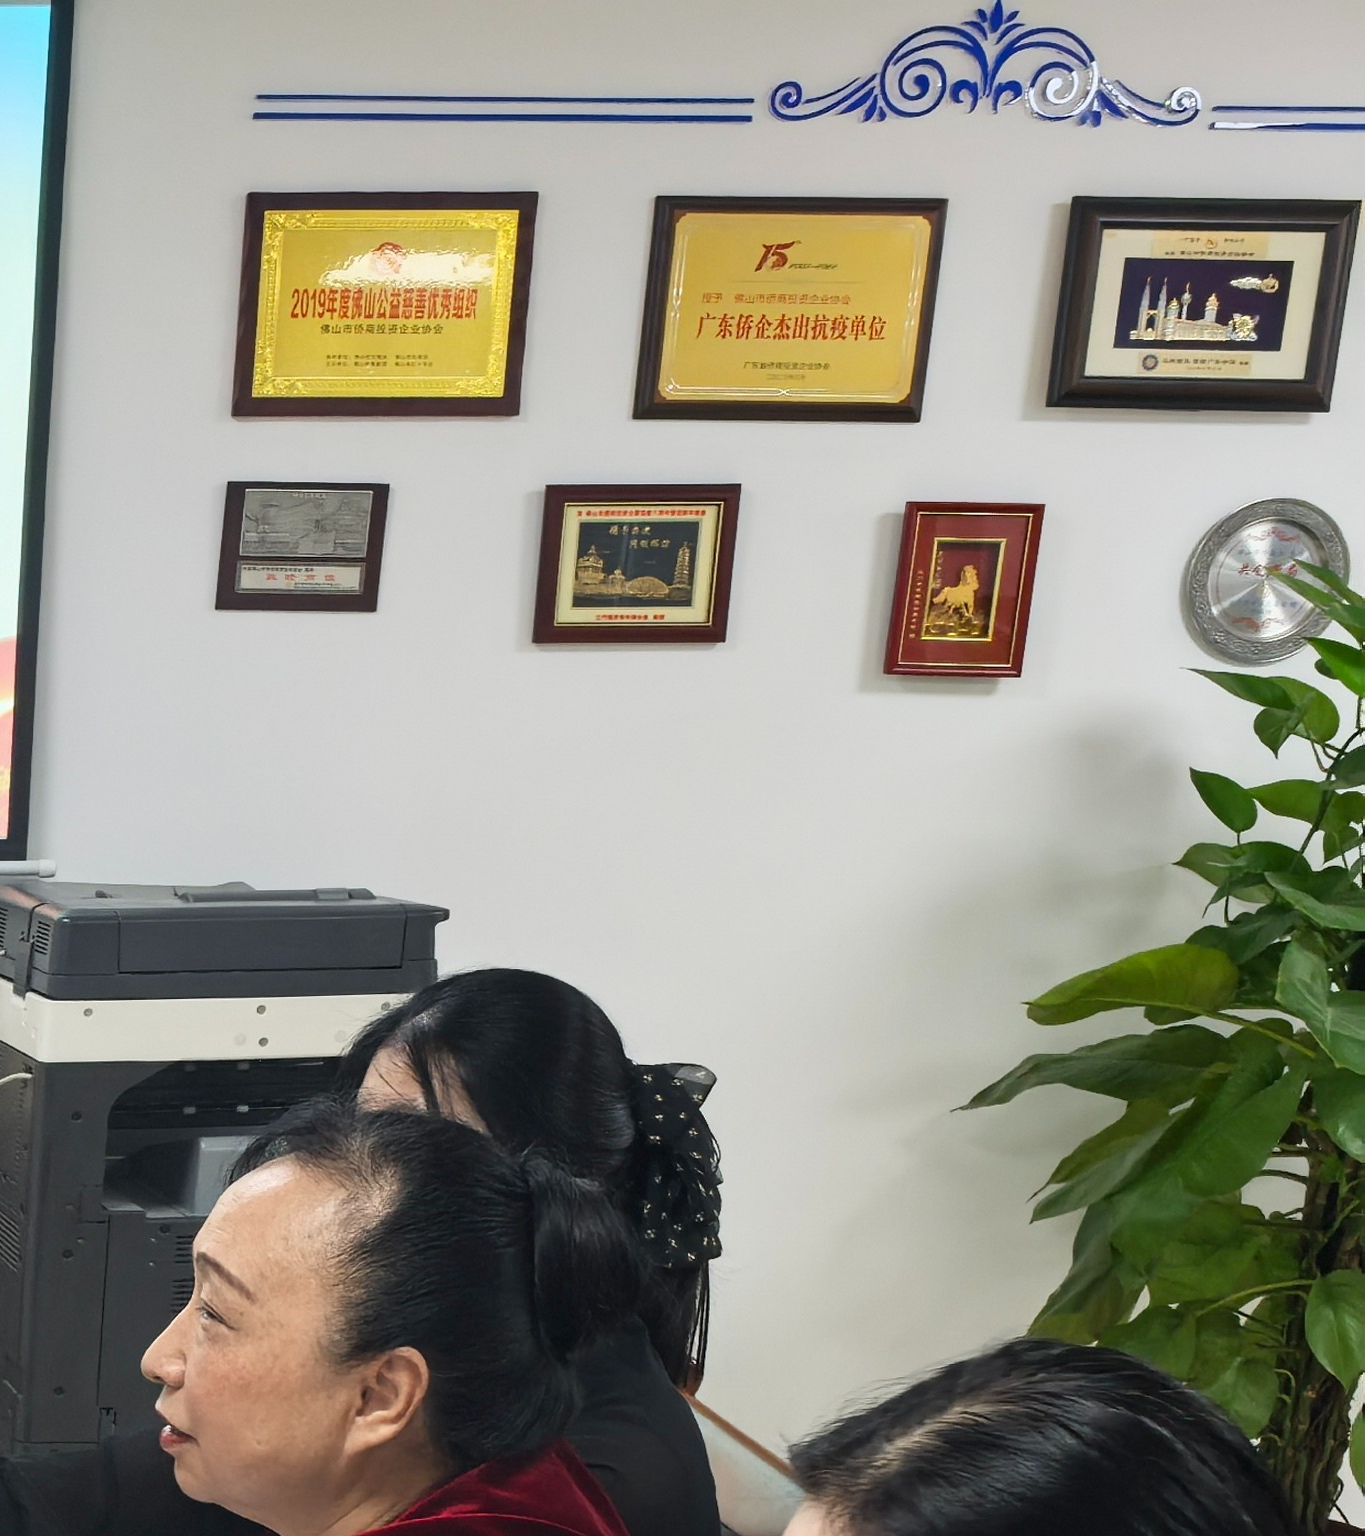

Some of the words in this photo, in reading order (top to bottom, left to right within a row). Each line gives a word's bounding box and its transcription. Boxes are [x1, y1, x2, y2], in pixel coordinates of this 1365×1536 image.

[291, 287, 478, 320] 2019年度佛山公益慈善优秀组织
[696, 312, 887, 342] 广东侨企杰出抗疫单位
